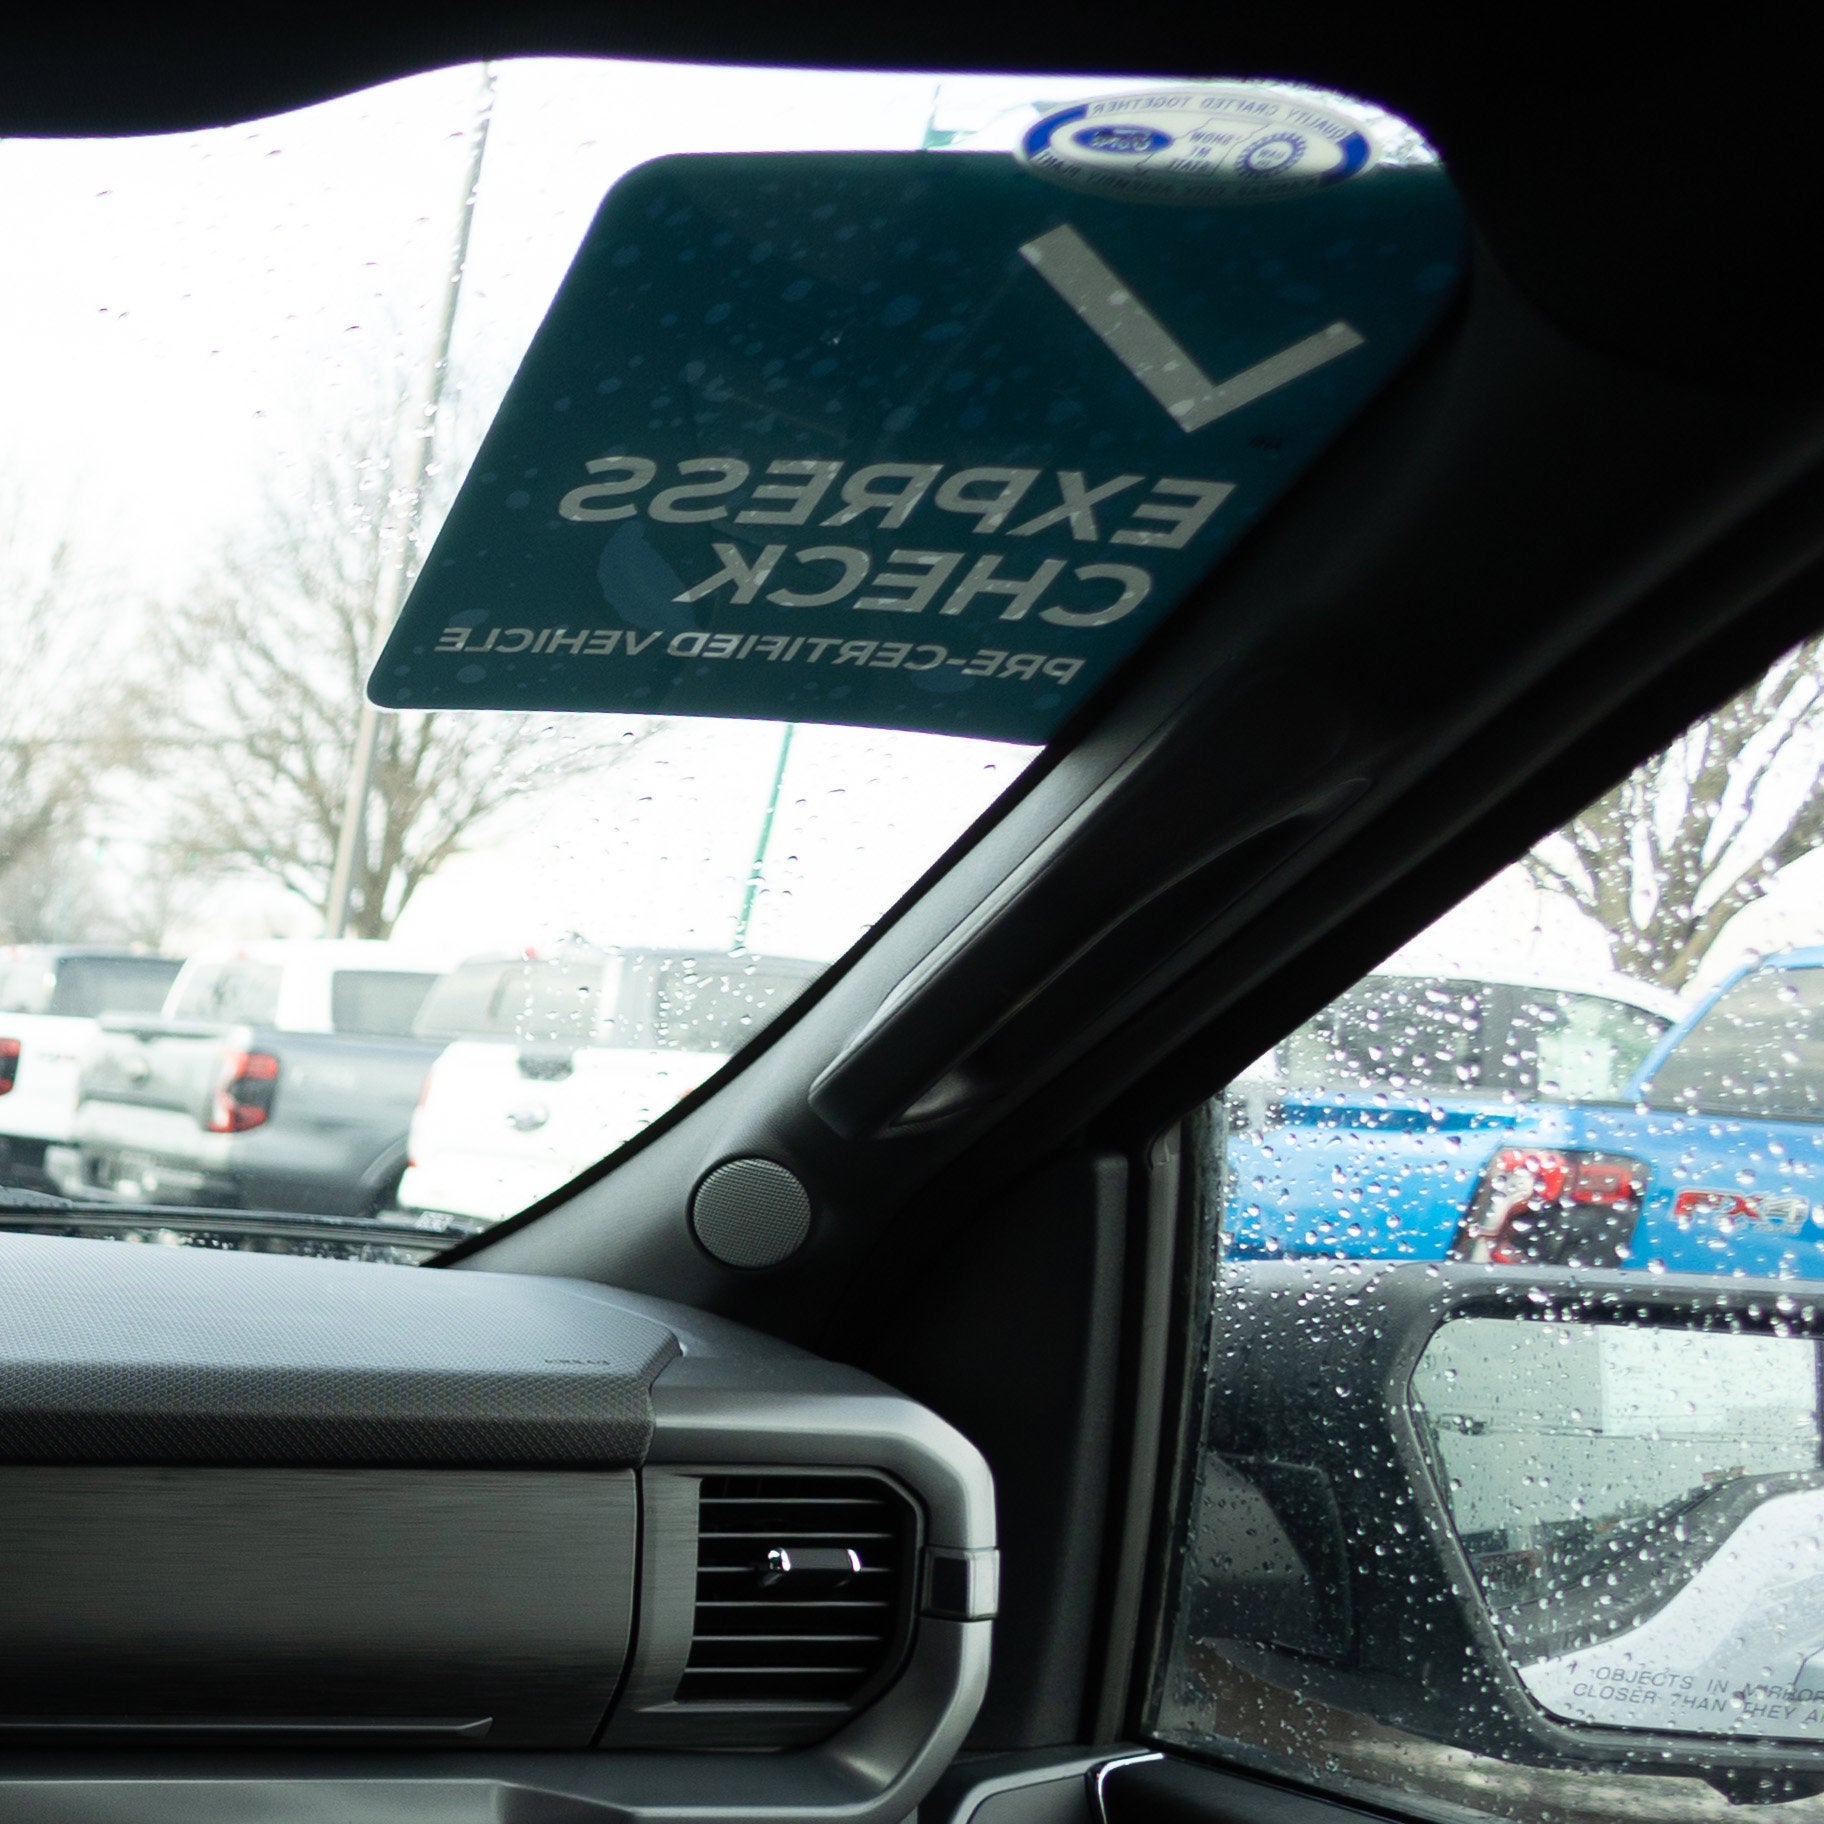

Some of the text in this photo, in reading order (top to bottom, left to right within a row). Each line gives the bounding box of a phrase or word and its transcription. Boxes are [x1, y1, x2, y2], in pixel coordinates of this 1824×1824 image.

[1572, 1682, 1654, 1703] CLOSER
[1671, 1692, 1724, 1712] THAN
[1742, 1702, 1798, 1720] THEY
[1593, 1666, 1824, 1701] OBJECTS IN MRROR
